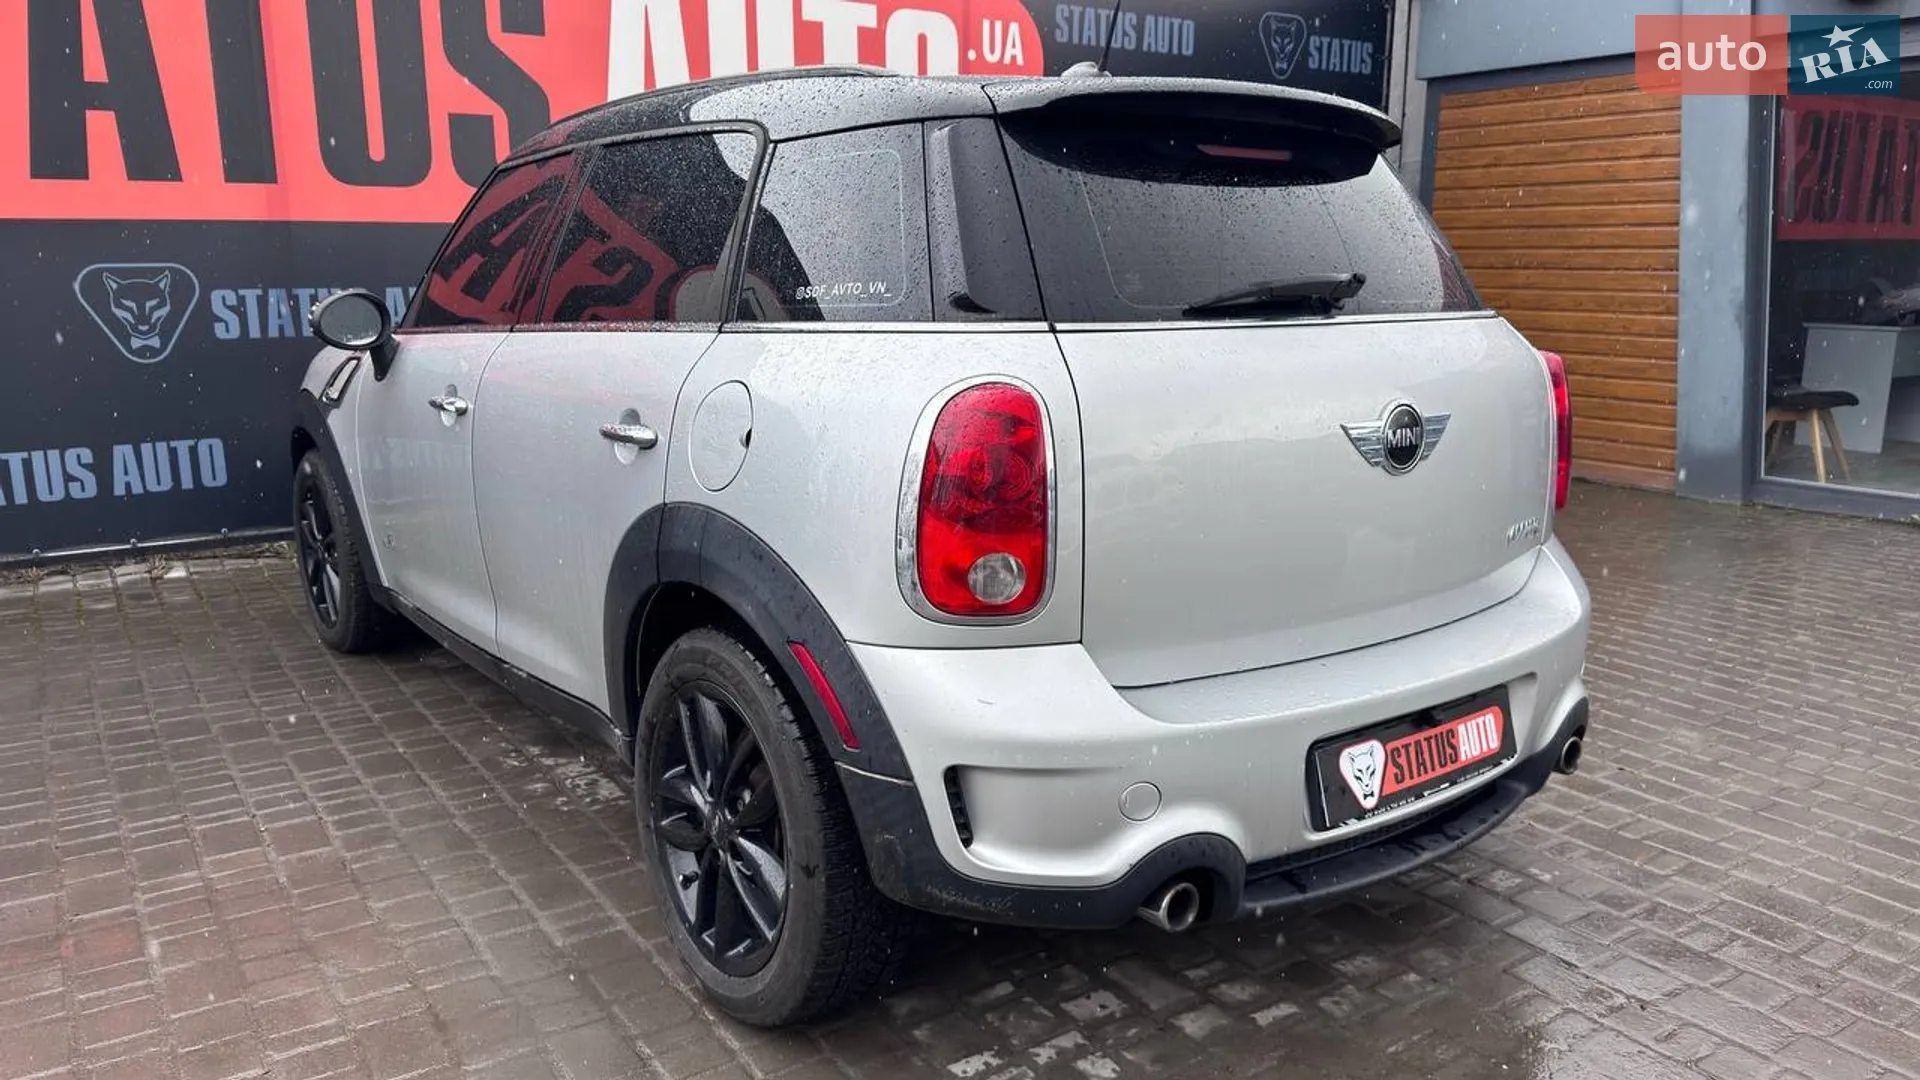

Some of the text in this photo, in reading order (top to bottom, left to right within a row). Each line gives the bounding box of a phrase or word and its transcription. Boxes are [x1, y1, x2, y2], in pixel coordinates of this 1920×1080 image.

[1055, 4, 1195, 56] STATUS AUTO
[1308, 36, 1373, 74] STATUS
[1387, 426, 1421, 448] MINI
[0, 438, 228, 506] TUS AUTO
[1390, 712, 1500, 784] STATUS AUTO
